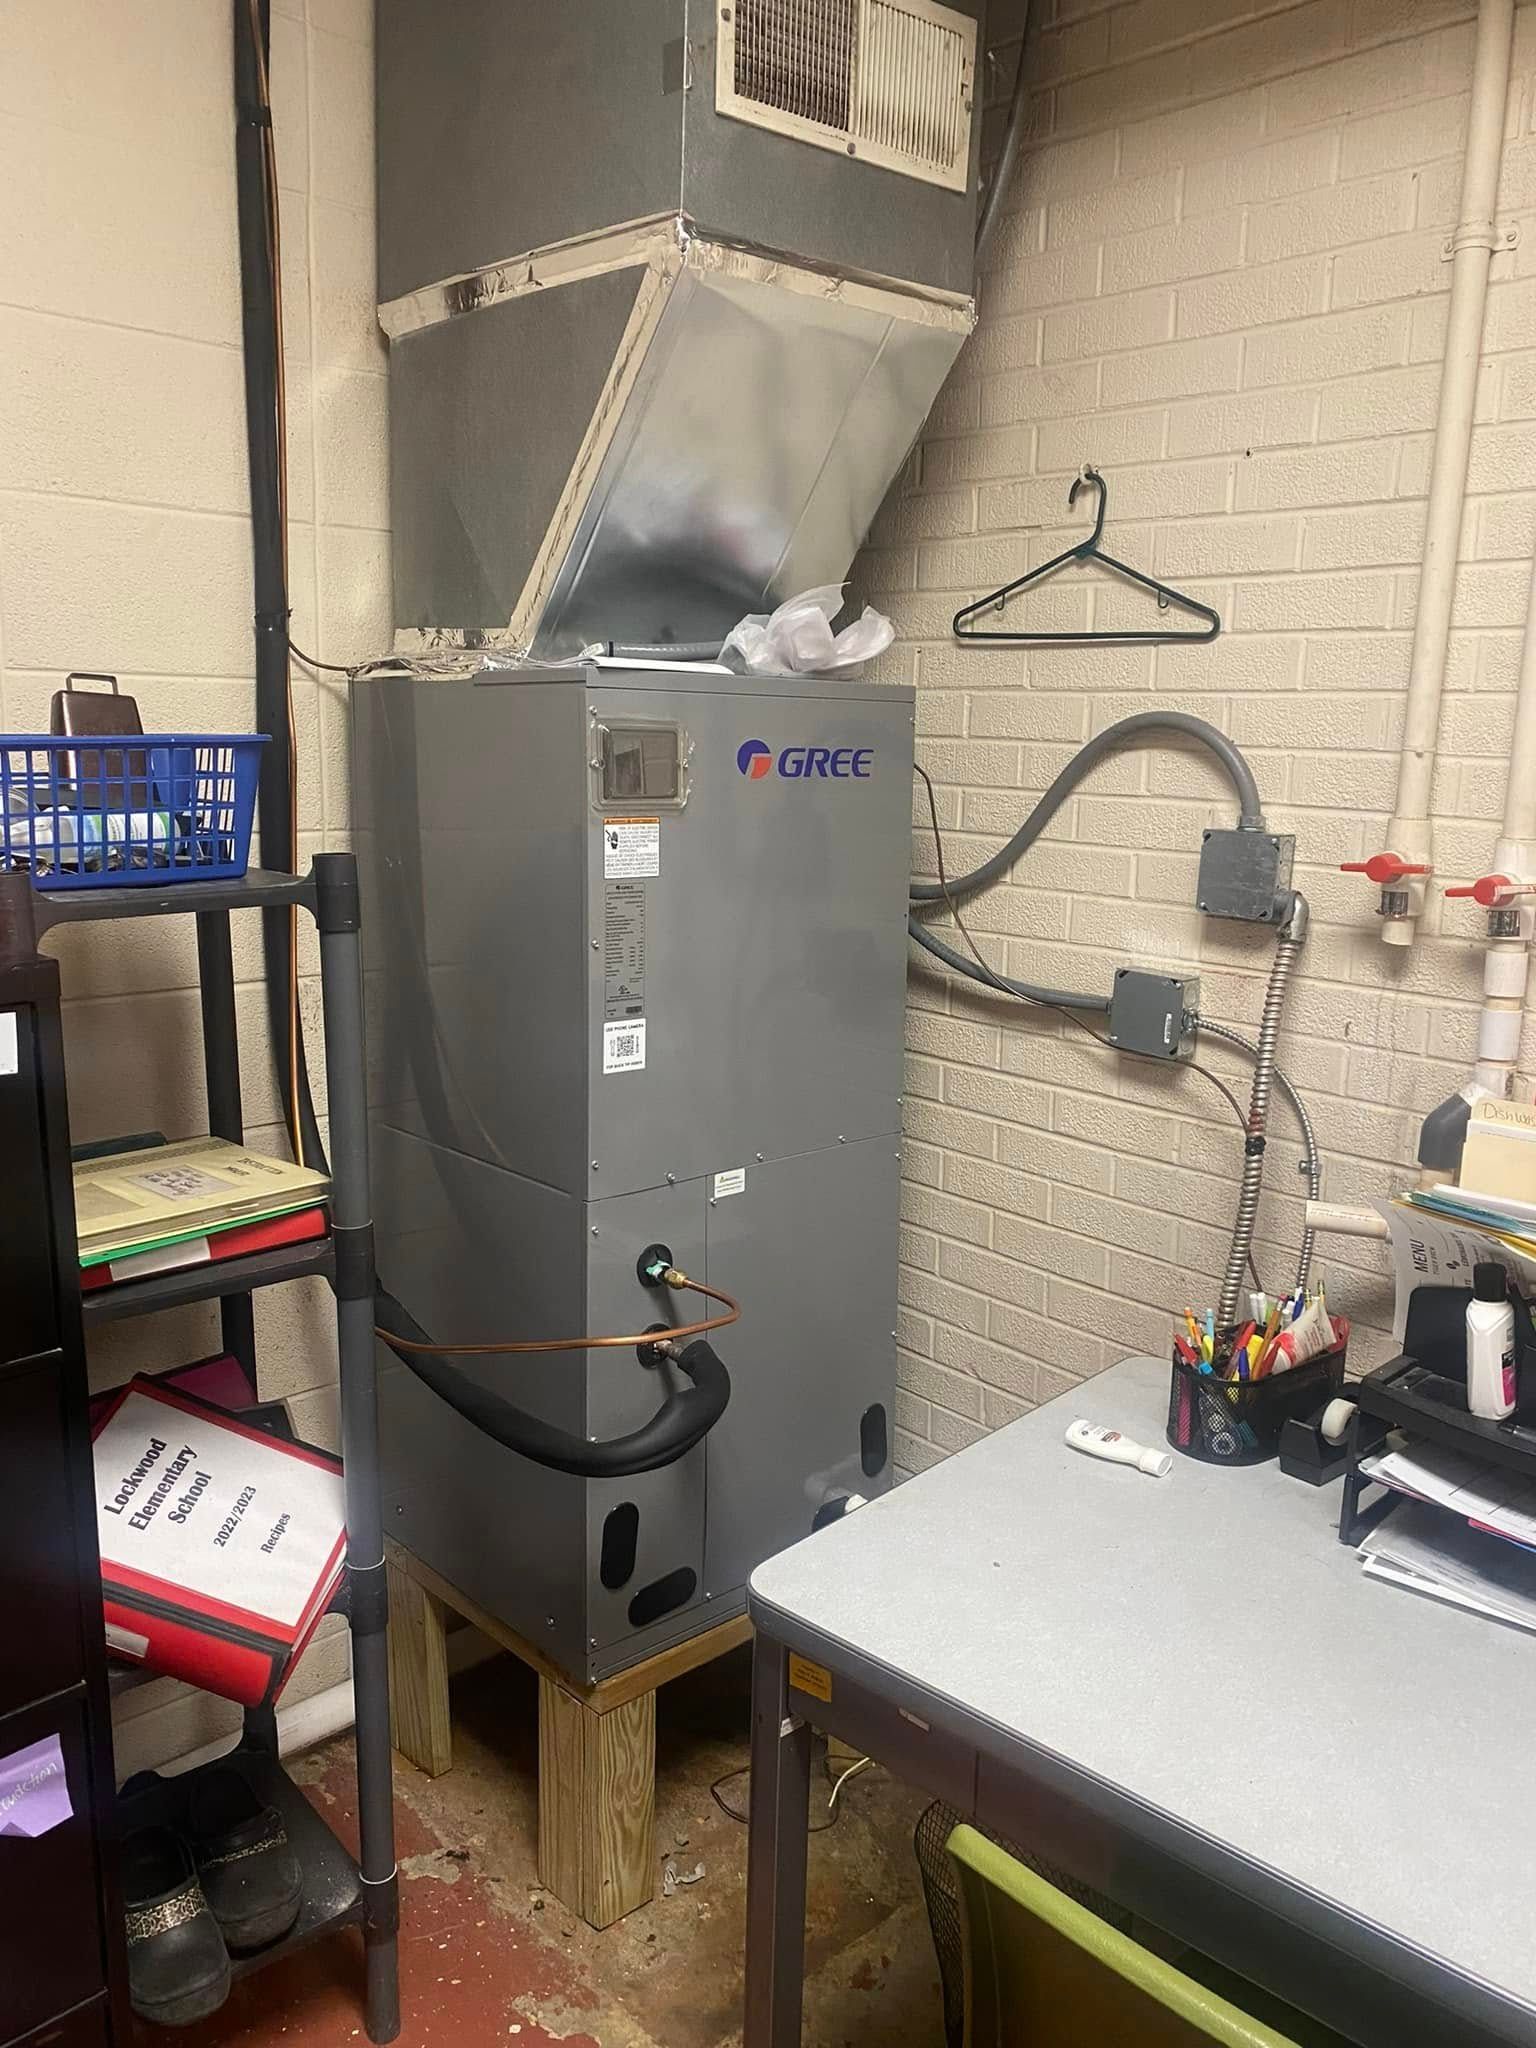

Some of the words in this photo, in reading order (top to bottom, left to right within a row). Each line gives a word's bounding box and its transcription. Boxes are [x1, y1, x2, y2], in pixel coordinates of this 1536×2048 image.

[778, 748, 874, 777] GREE
[1409, 1239, 1428, 1273] MENU
[103, 1437, 168, 1515] Lockwood
[128, 1444, 198, 1531] Elementary
[167, 1470, 212, 1525] School
[213, 1485, 257, 1548] 2022/2023
[260, 1512, 291, 1554] Recipes
